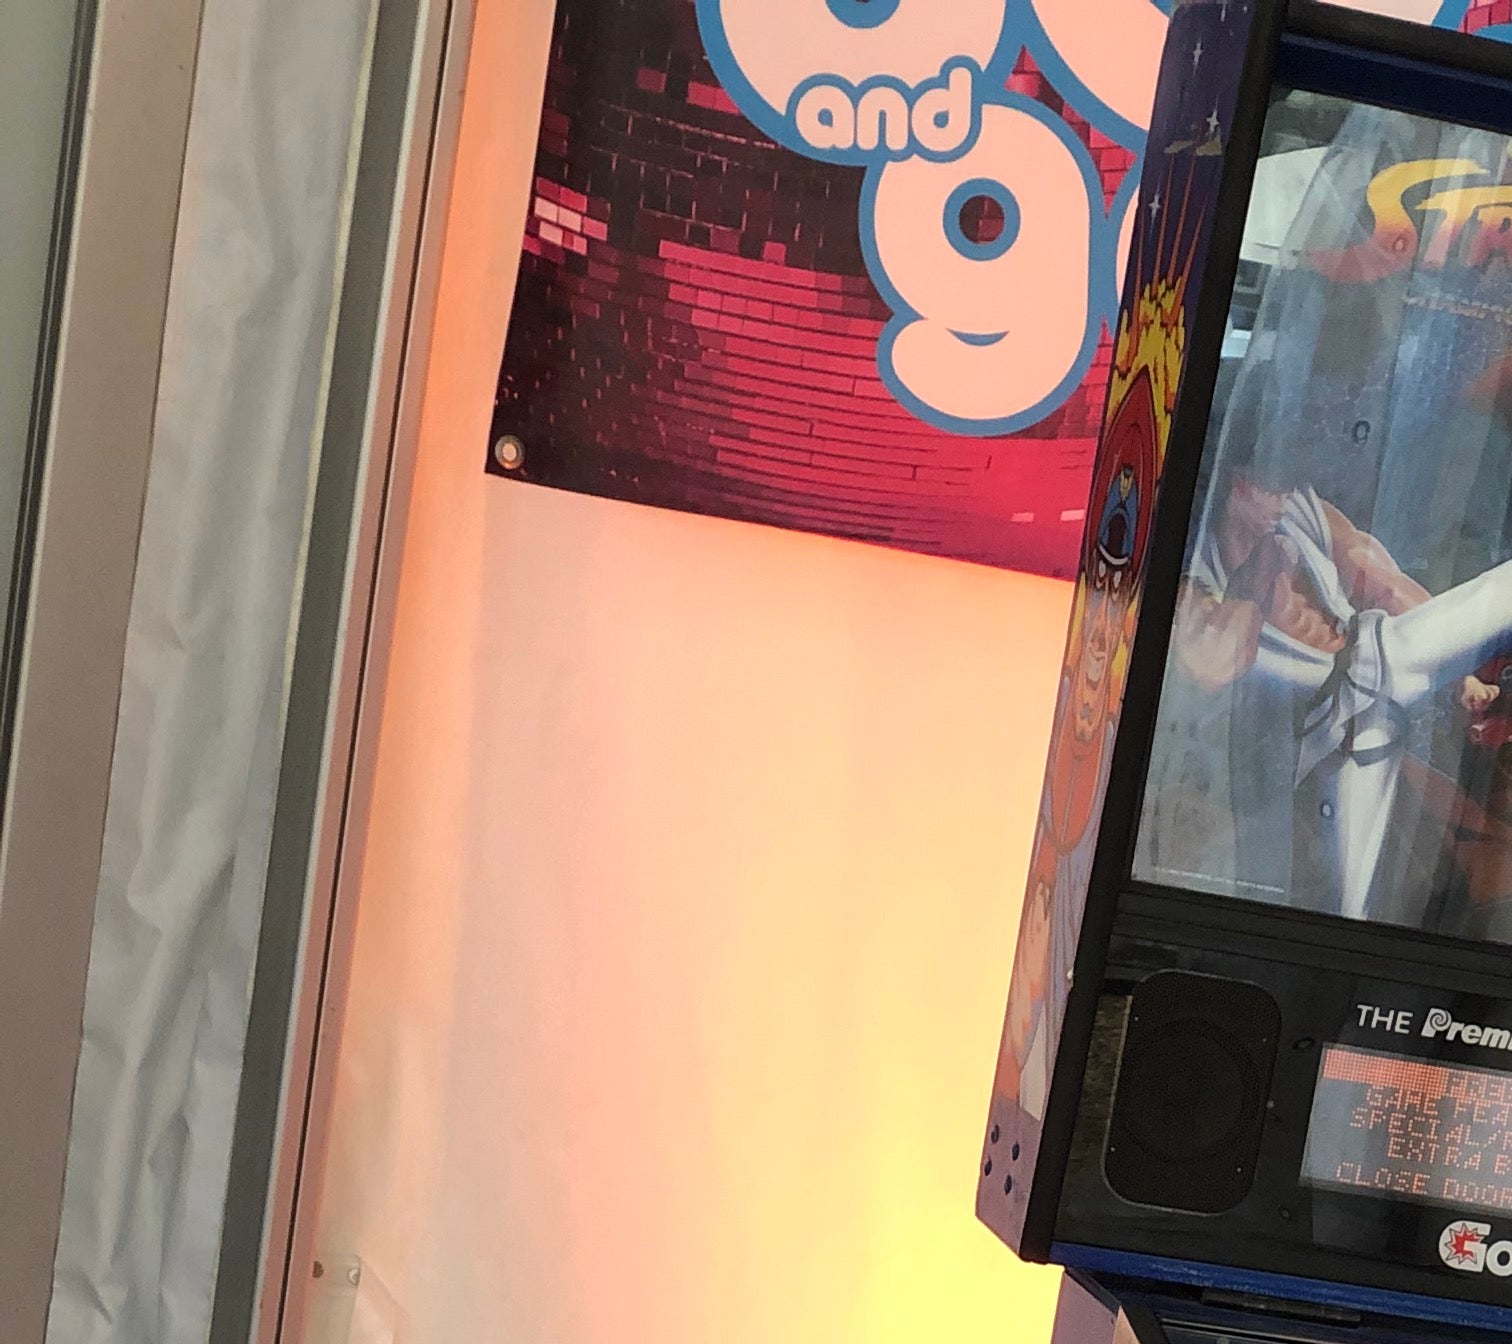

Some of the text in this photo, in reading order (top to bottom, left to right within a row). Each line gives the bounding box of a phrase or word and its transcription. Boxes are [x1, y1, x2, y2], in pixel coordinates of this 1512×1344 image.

[792, 62, 976, 155] and
[1356, 1004, 1413, 1036] THE
[1364, 1084, 1441, 1116] GAME
[1387, 1136, 1483, 1171] EXTRA
[1334, 1161, 1431, 1195] CLOSE
